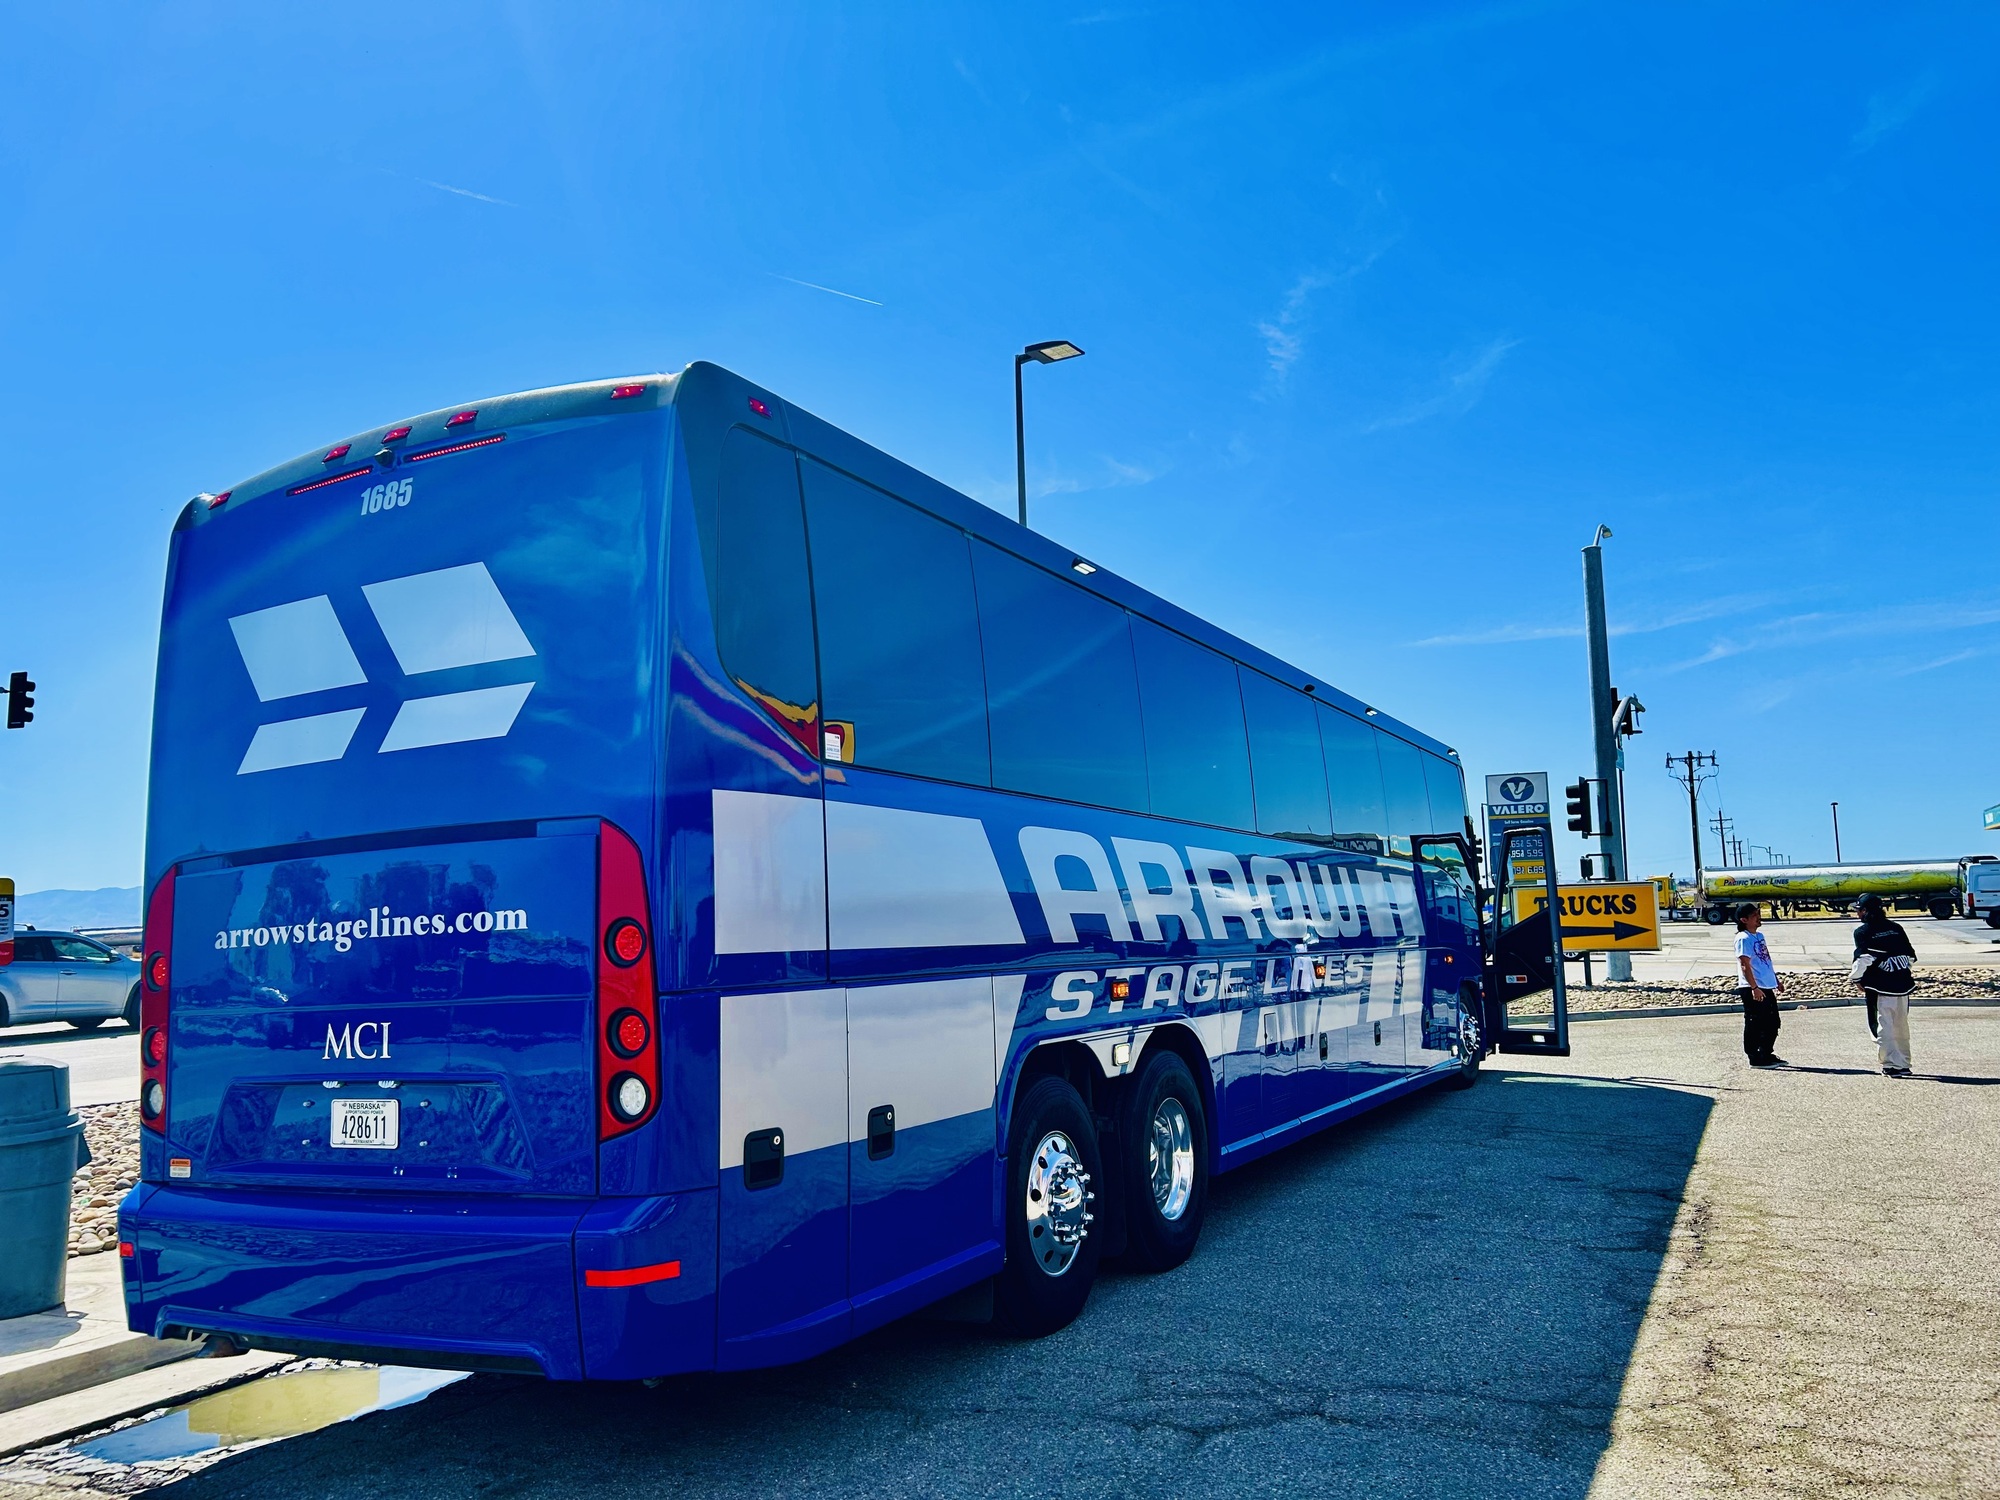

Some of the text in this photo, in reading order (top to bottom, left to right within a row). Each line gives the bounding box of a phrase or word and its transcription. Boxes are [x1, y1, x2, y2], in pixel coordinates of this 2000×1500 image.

[361, 477, 414, 516] 1685
[1492, 804, 1545, 815] VALERO
[1526, 839, 1543, 848] 5.75
[1018, 826, 1361, 944] ARROW
[1749, 878, 1769, 886] TANK
[1770, 877, 1790, 886] LINES
[214, 905, 528, 952] arrowstagelines.com
[1045, 960, 1252, 1021] STAGE
[322, 1022, 392, 1060] MCI
[341, 1115, 387, 1139] 428611
